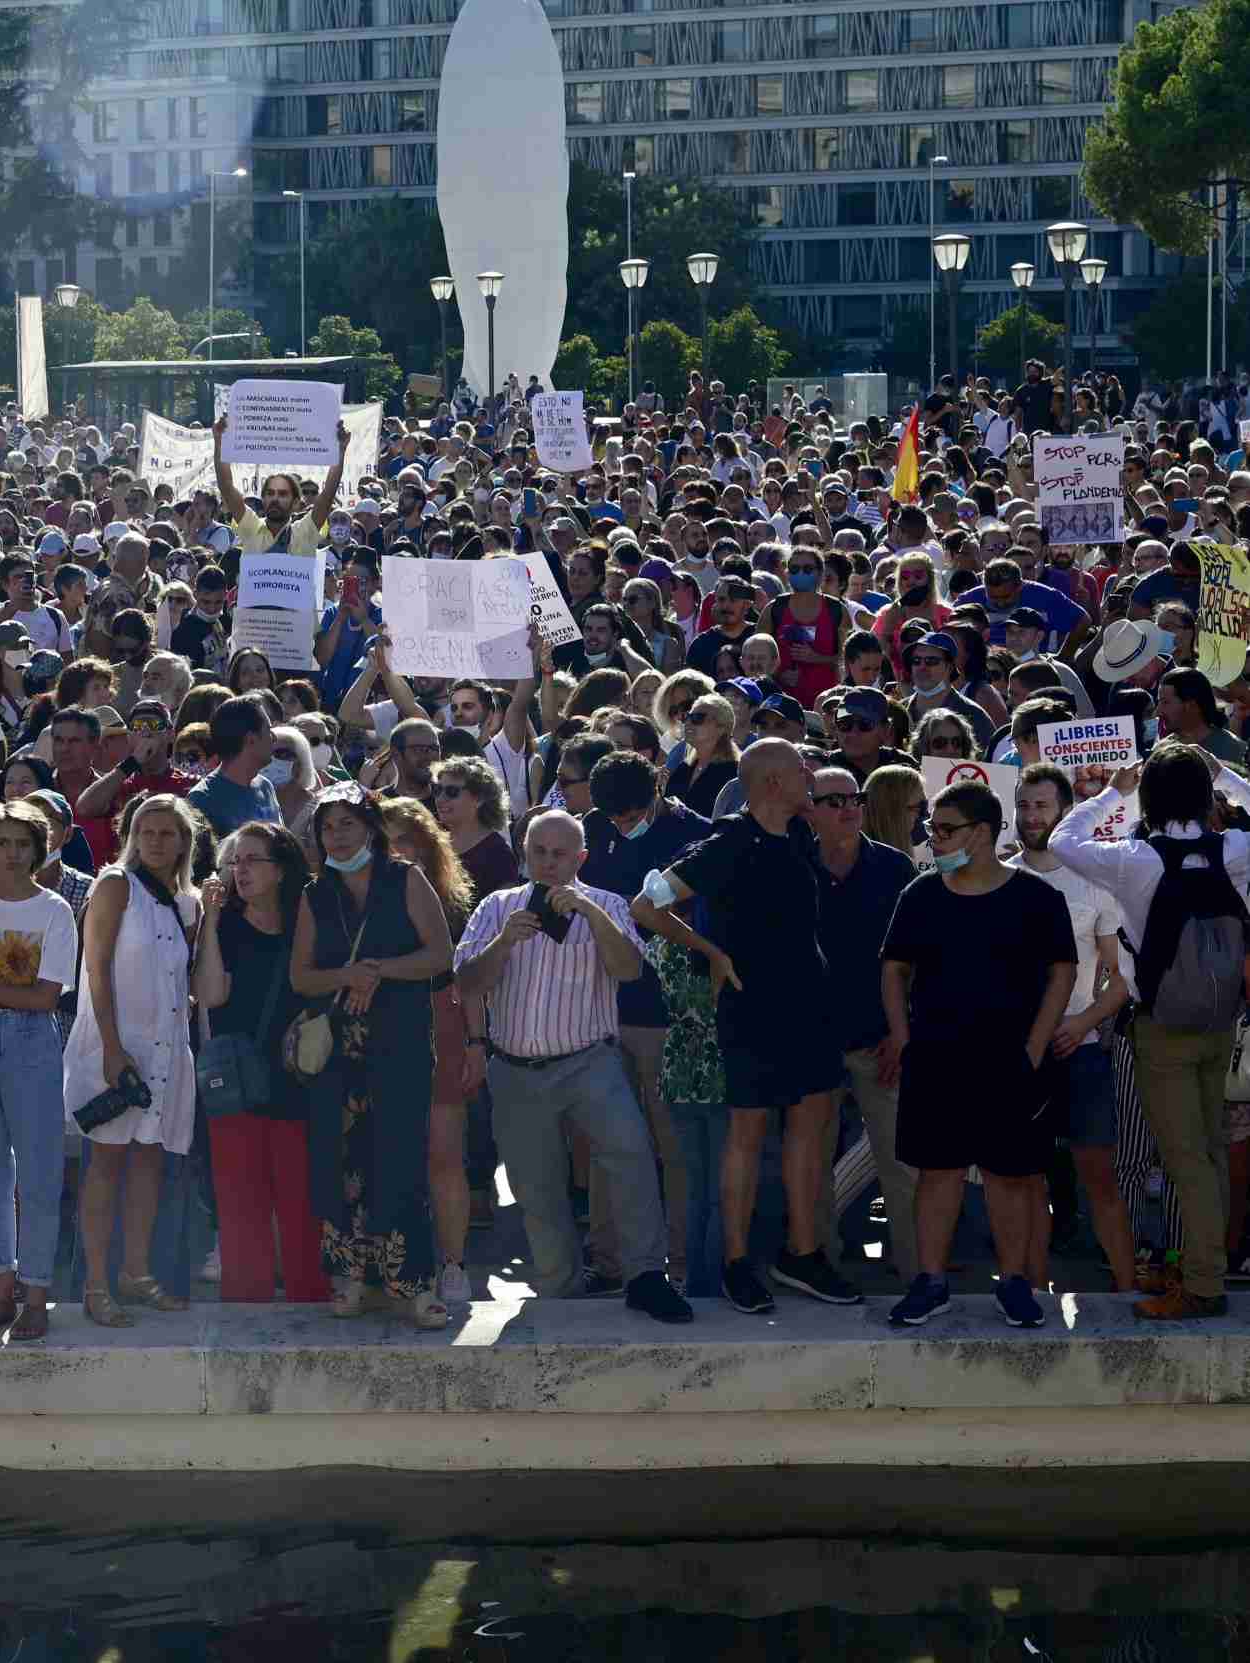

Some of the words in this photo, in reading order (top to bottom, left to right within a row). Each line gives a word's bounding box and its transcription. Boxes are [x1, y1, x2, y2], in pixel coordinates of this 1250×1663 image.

[1044, 445, 1086, 461] STOP
[1040, 474, 1085, 491] STOP
[253, 582, 301, 593] TERRORISTA
[531, 591, 558, 600] UERPO
[1054, 723, 1119, 744] ¡LIBRES!
[1044, 738, 1133, 756] CONSCIENTES
[1062, 755, 1083, 766] SIN
[1086, 750, 1128, 764] MIEDO
